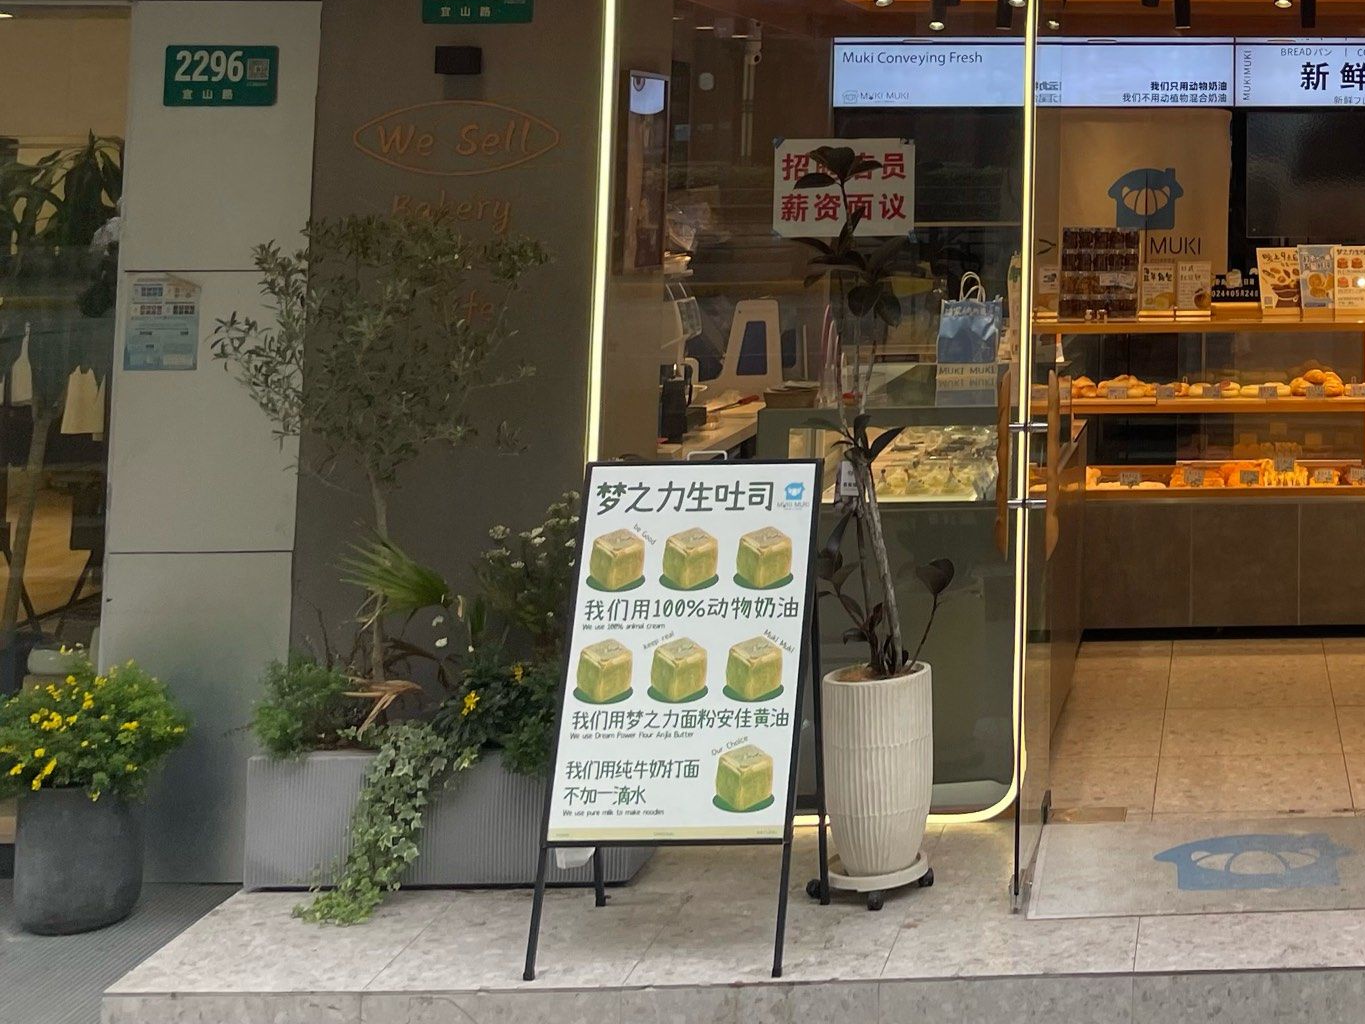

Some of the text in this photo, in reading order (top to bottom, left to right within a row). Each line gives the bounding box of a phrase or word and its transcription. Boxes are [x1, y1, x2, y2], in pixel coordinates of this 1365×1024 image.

[440, 6, 491, 17] 宜山路
[842, 51, 983, 66] Muki Conveying Fresh
[1280, 48, 1312, 57] BREAD
[1314, 48, 1333, 57] パン
[174, 50, 244, 82] 2296
[1242, 50, 1252, 101] MUKIMUKI
[182, 88, 233, 100] 宜山路
[1150, 81, 1228, 91] 我们只用动物奶油
[1122, 92, 1228, 103] 我们不用动植物混合奶油
[376, 119, 532, 156] We Sell
[781, 193, 907, 222] 薪资面议
[1150, 237, 1201, 256] MUKI
[939, 367, 996, 375] MUKI MUKI
[596, 481, 775, 516] 梦之力生吐司
[584, 597, 799, 622] 我们用100%动物奶油
[572, 707, 790, 731] 我们用梦之力面粉安佳黄油
[565, 759, 700, 780] 我们用纯牛奶打面
[563, 785, 647, 805] 不加一滴水
